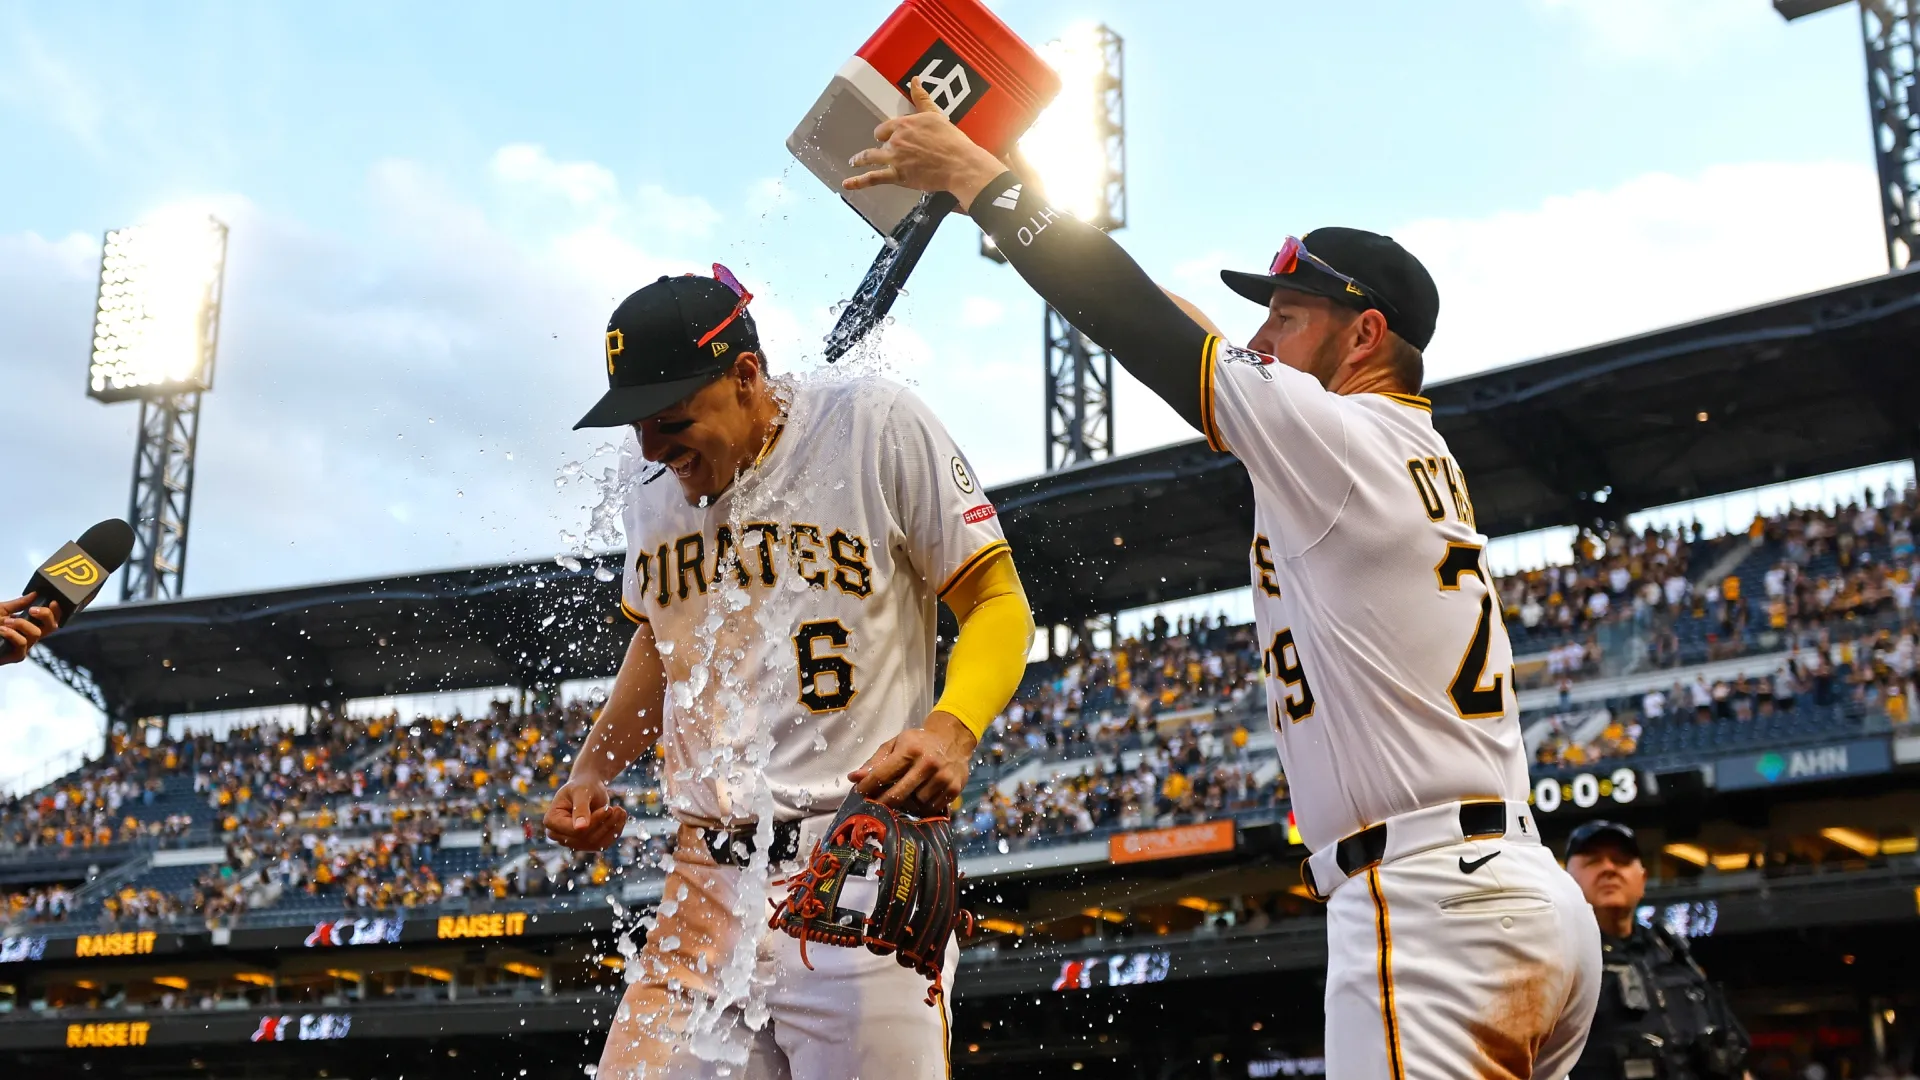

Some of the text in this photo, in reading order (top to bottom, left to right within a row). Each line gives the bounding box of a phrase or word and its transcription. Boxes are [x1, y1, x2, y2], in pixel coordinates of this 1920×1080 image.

[606, 328, 625, 375] P
[955, 463, 970, 486] 9
[791, 618, 860, 714] 6
[1788, 746, 1848, 778] AHN
[895, 836, 916, 903] marucci
[437, 912, 528, 939] RAISE IT
[76, 932, 136, 957] RAISE
[136, 931, 157, 954] IT
[66, 1021, 151, 1048] RAISE IT
